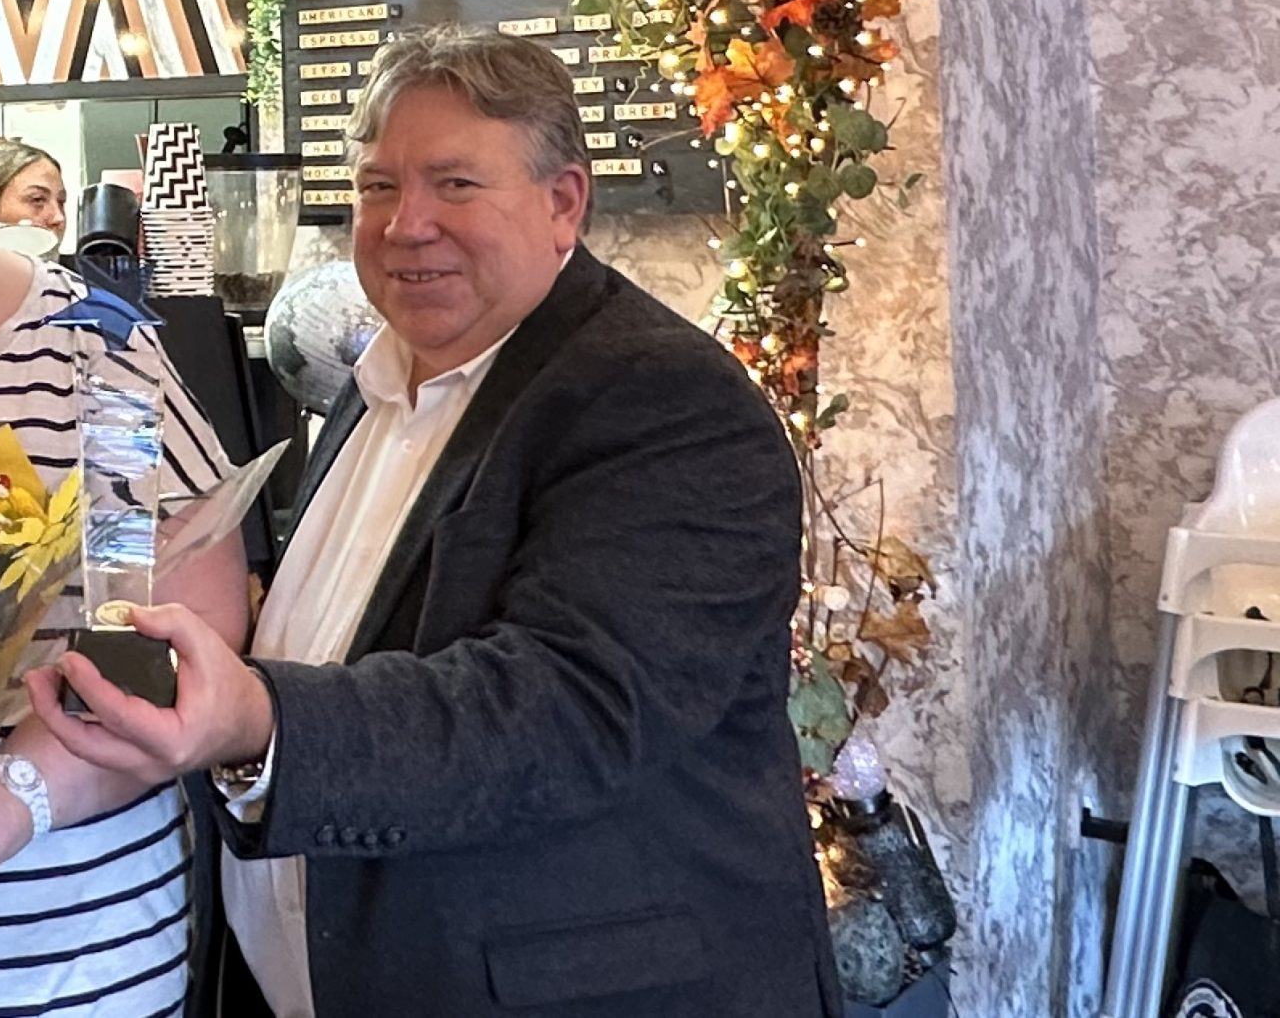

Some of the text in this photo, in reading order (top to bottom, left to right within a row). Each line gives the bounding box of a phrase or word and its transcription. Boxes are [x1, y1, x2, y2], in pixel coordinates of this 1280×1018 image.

[300, 6, 385, 22] AMERICANO
[576, 17, 611, 28] TEA
[301, 32, 376, 47] ESPRESSO
[616, 103, 674, 117] GREEN
[303, 144, 339, 154] CHAI
[303, 168, 352, 179] MOCHA
[593, 163, 637, 174] CHAI
